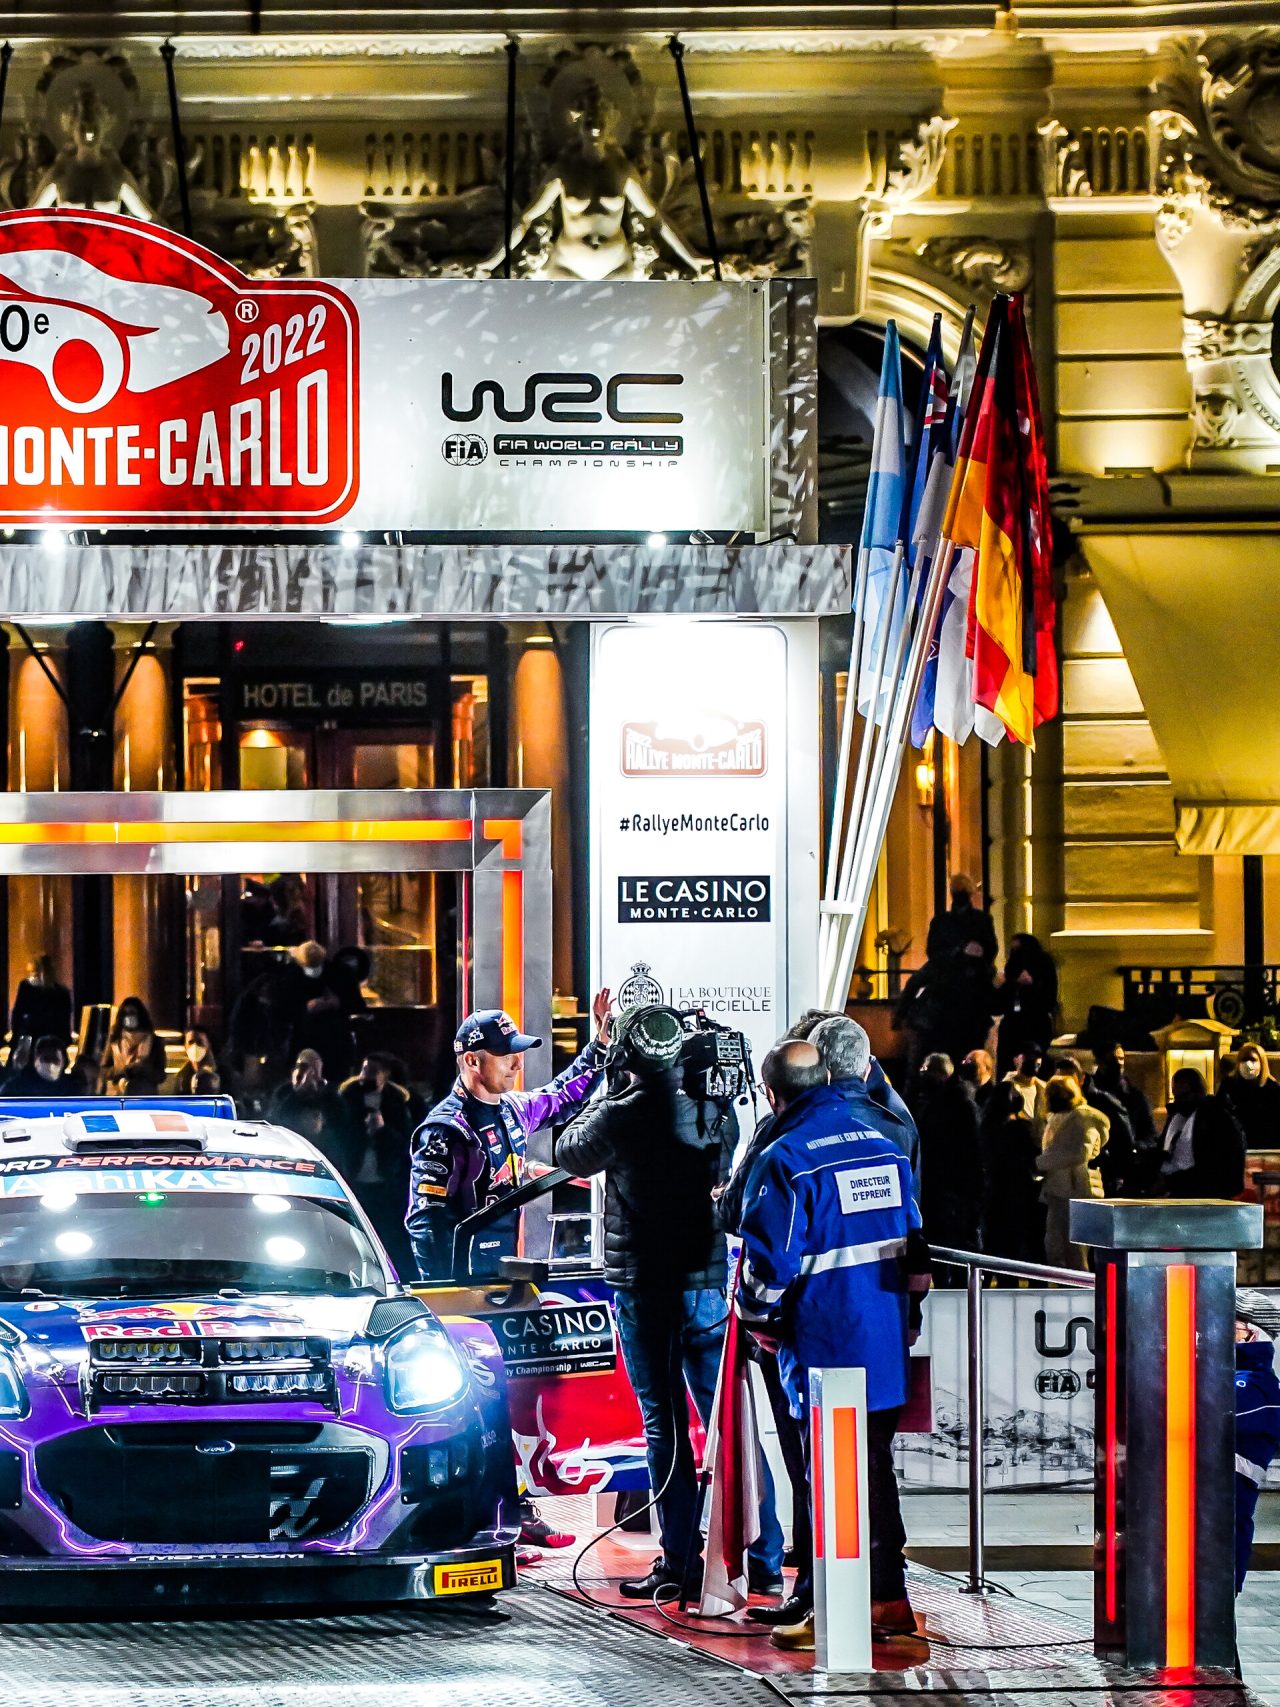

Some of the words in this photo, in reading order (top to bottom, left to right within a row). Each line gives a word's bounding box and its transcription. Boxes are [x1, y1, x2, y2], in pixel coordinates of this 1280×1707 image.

[241, 304, 327, 385] 2022
[442, 372, 684, 423] WRC
[499, 440, 528, 451] FIA
[534, 440, 605, 451] WORLD
[610, 439, 680, 451] RALLY
[499, 460, 678, 468] CHAMPIONSHIP
[244, 684, 320, 707] HOTEL
[327, 684, 354, 707] de
[360, 682, 428, 707] PARIS
[619, 813, 769, 835] #RallyeMonteCarlo
[622, 882, 649, 902] LE
[656, 880, 767, 902] CASINO
[679, 987, 694, 998] LA
[699, 987, 771, 1001] BOUTIQUE
[57, 1155, 316, 1173] PERFORMANCE
[850, 1176, 891, 1190] DIRECTEUR
[852, 1188, 891, 1201] D'EPREUVE
[84, 1321, 192, 1338] Red
[502, 1311, 606, 1338] CASINO
[516, 1363, 572, 1375] Championship
[442, 1567, 498, 1588] PIRELLI
